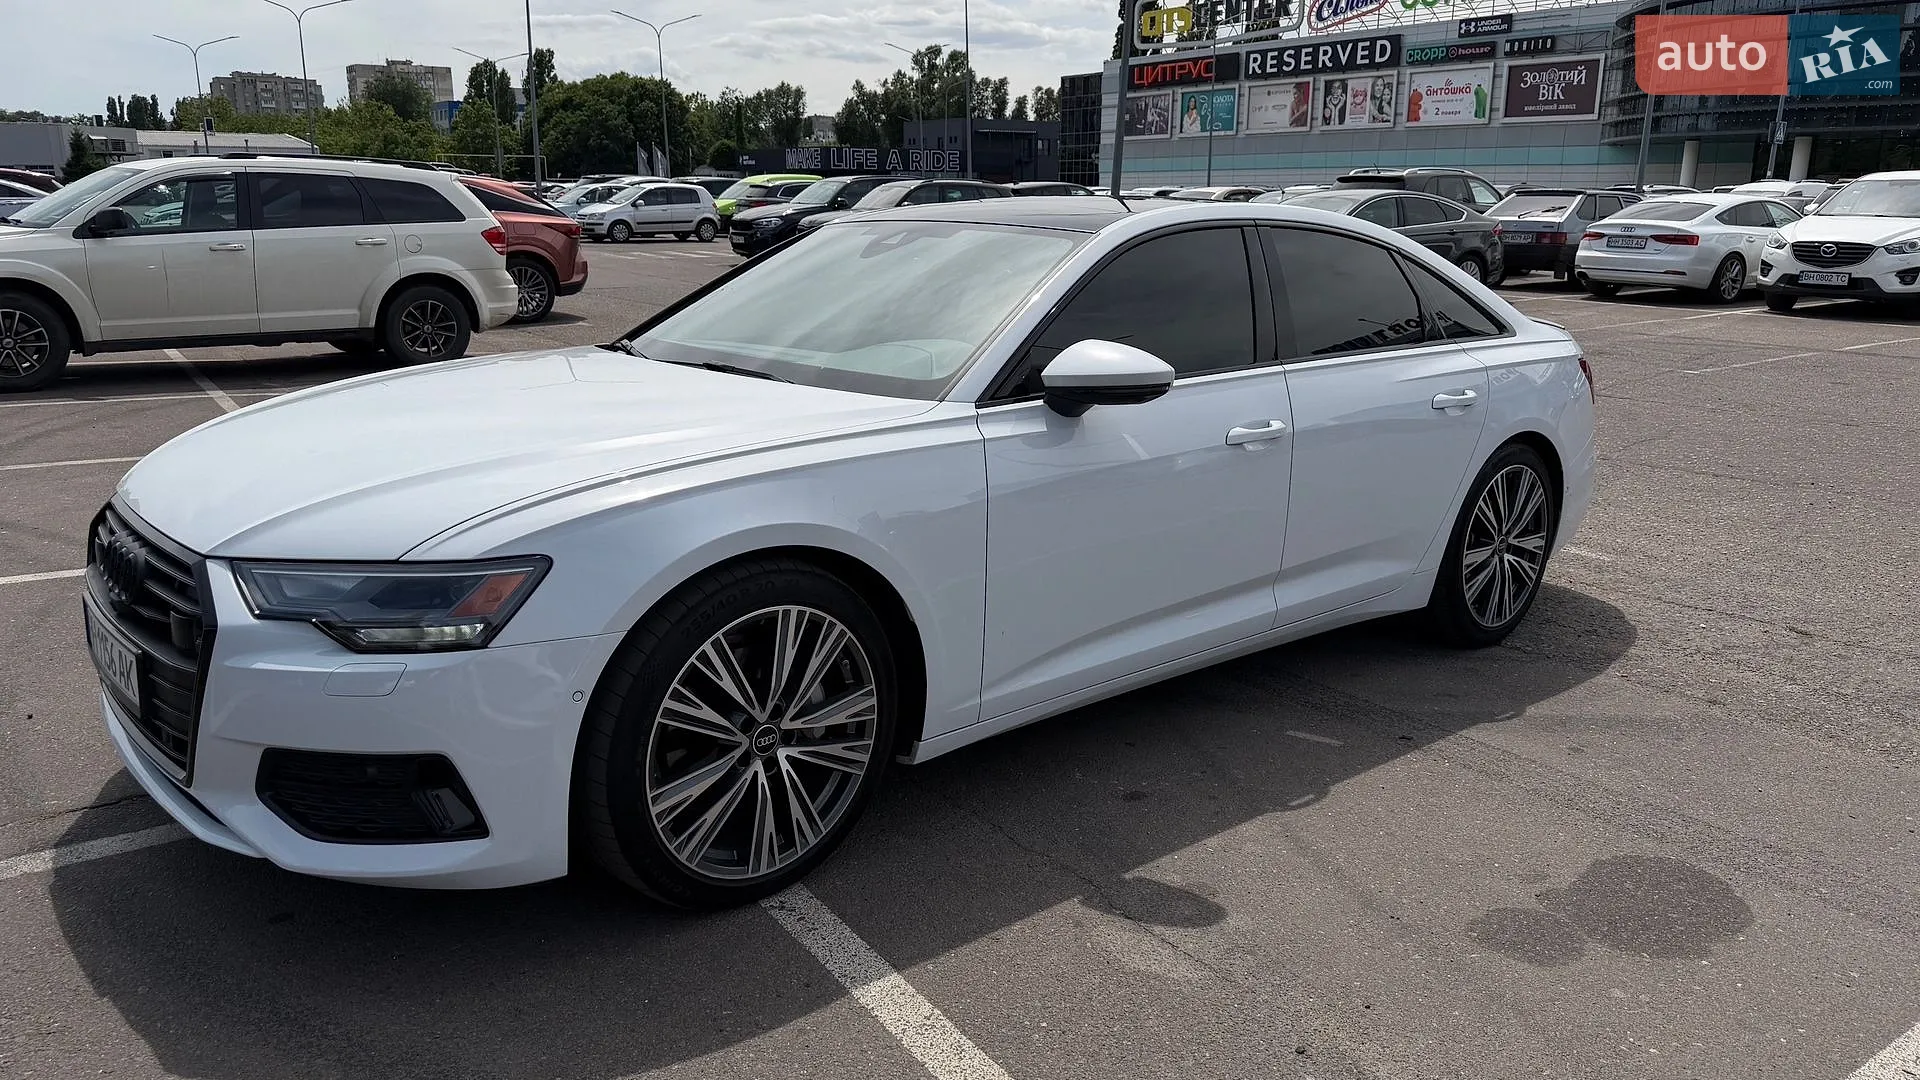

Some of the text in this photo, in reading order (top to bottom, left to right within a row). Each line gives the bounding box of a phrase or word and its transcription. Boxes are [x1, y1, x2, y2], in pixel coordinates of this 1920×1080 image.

[1477, 18, 1502, 27] UNDER
[1477, 23, 1508, 33] ARMOUR
[1458, 46, 1491, 56] house
[1504, 38, 1552, 52] MOHITO
[1249, 39, 1391, 75] RESERVED
[1406, 48, 1447, 62] CROPP
[1134, 58, 1215, 86] ЦИТРУС
[1434, 107, 1440, 116] 2
[786, 148, 960, 171] MAKE LIFE A RIDE
[1803, 271, 1815, 280] BH
[1835, 274, 1846, 282] TC
[118, 647, 137, 698] AK
